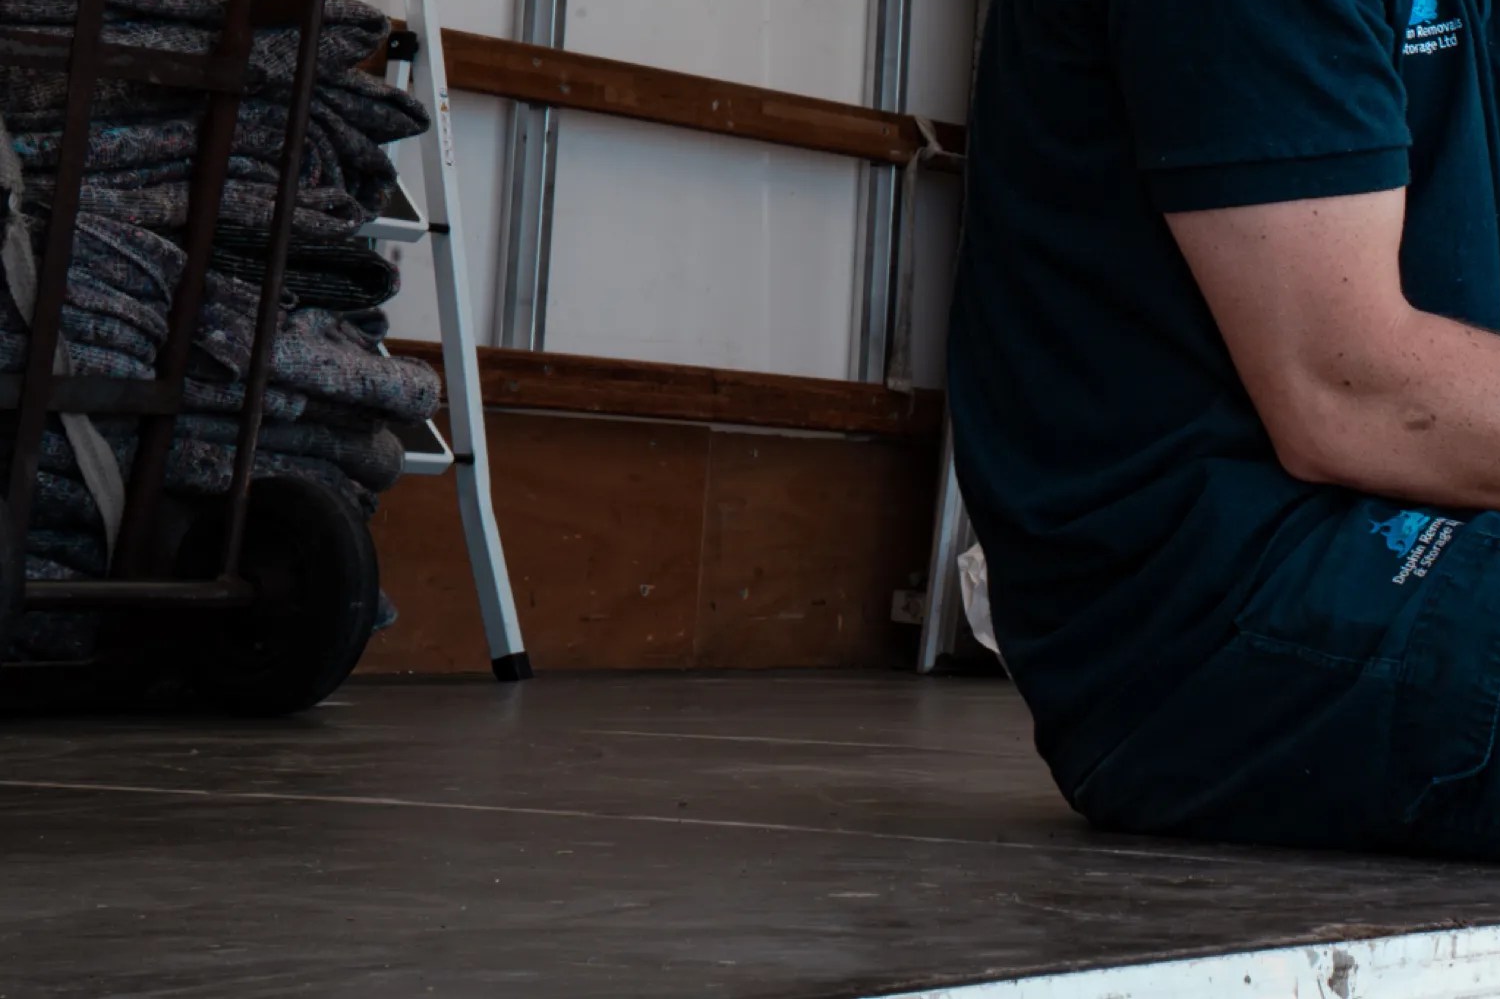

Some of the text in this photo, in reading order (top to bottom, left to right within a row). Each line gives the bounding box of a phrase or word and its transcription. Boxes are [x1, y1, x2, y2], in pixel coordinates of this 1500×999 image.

[1438, 33, 1458, 48] Ltd
[1392, 544, 1427, 585] Dolphin
[1420, 525, 1453, 568] Storage
